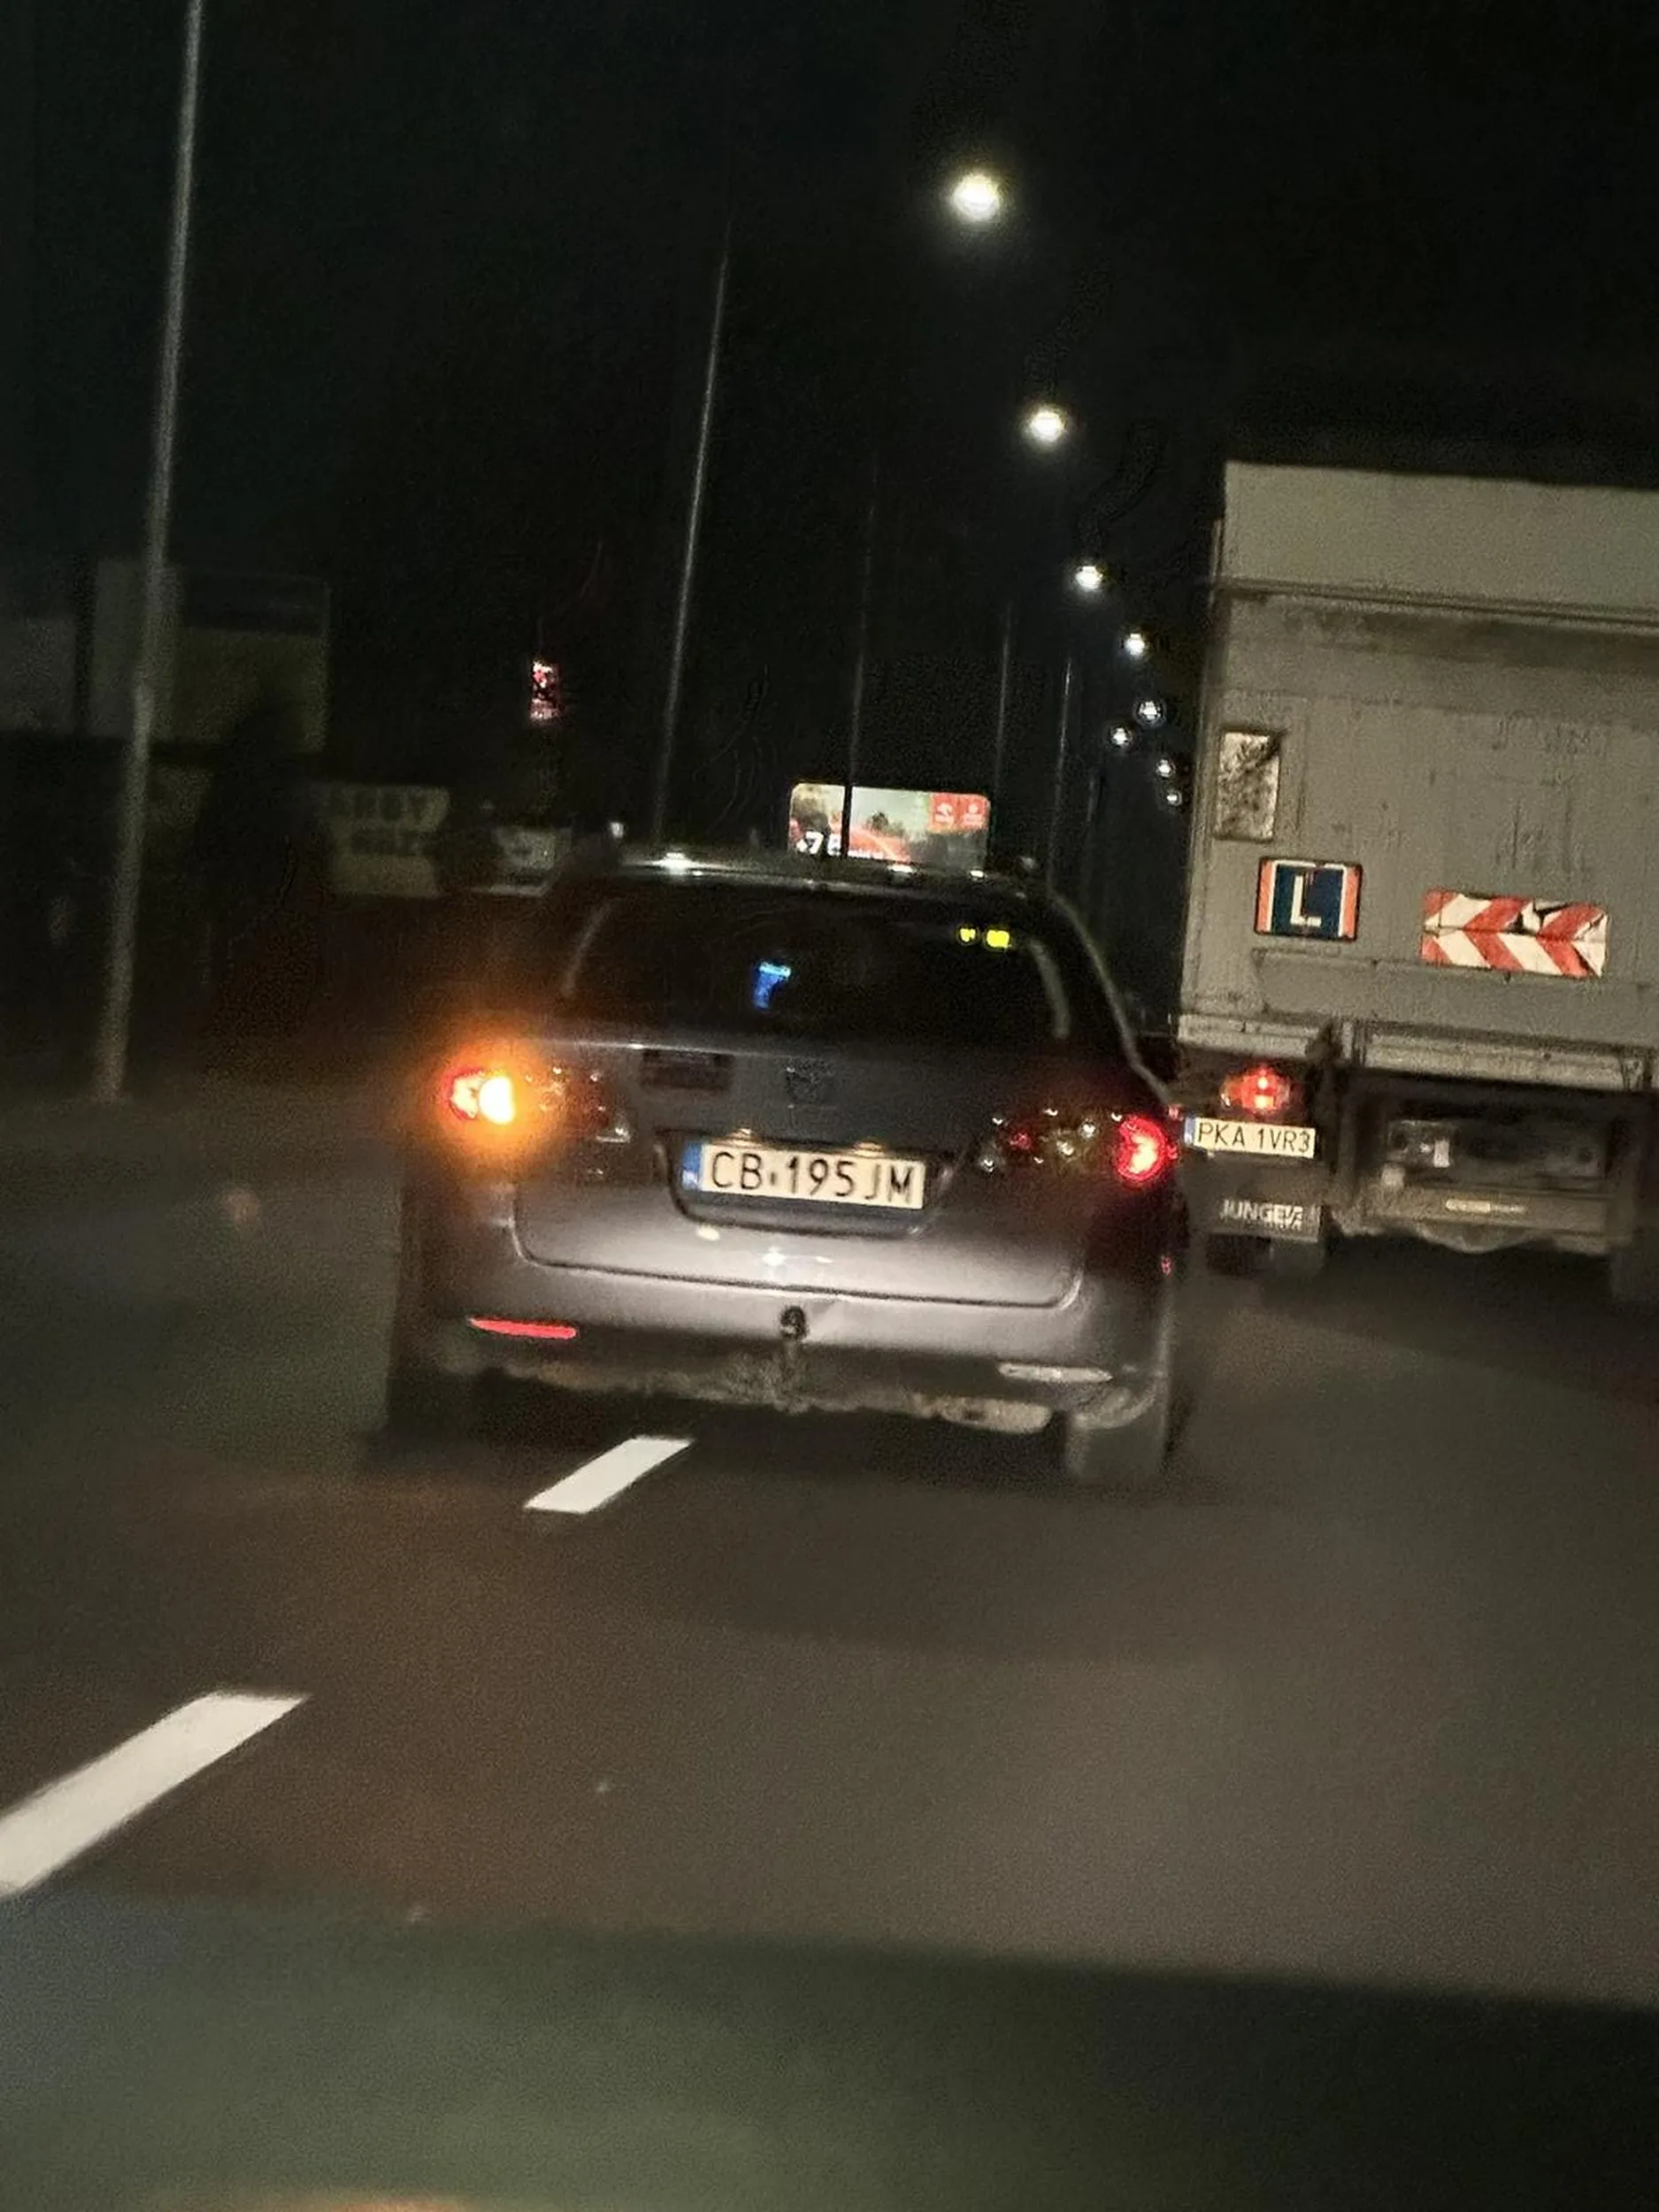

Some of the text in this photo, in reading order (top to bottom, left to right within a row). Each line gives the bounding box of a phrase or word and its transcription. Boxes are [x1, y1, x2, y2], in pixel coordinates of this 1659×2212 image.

[1290, 875, 1322, 926] L
[1197, 1122, 1310, 1154] PKA 1VR3
[711, 1151, 913, 1204] CB 195JM
